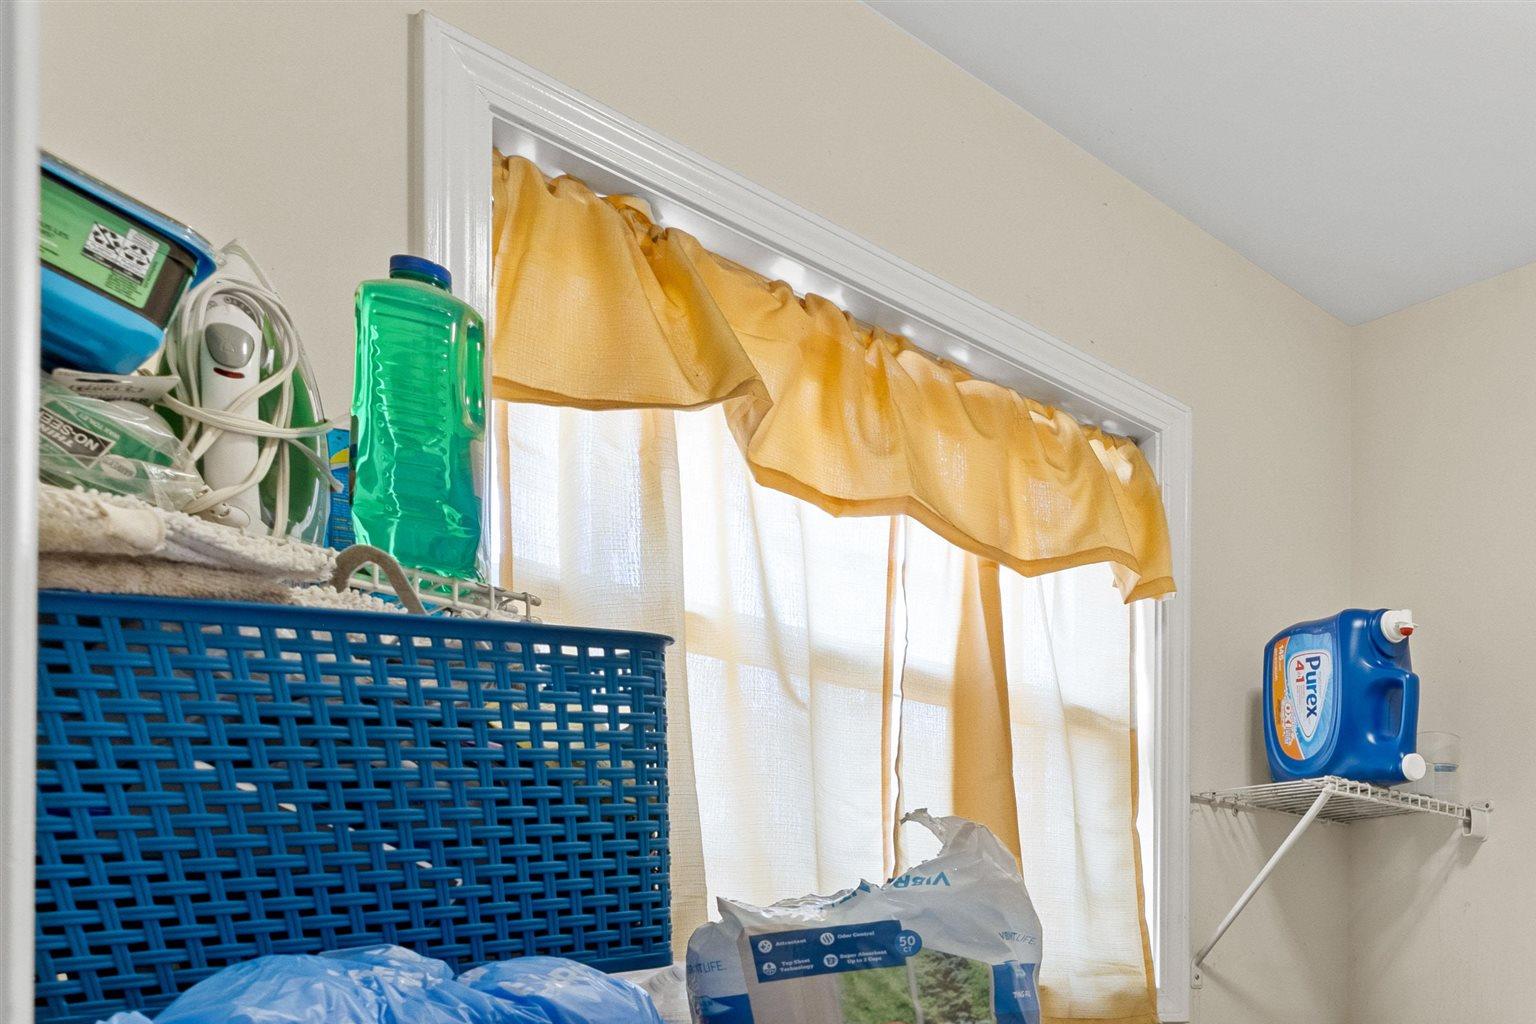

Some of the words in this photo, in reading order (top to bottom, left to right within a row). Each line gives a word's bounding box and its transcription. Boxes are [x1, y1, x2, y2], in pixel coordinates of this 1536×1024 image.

[39, 410, 99, 451] NO-SEE
[1305, 656, 1320, 718] Purex
[899, 935, 916, 947] 50
